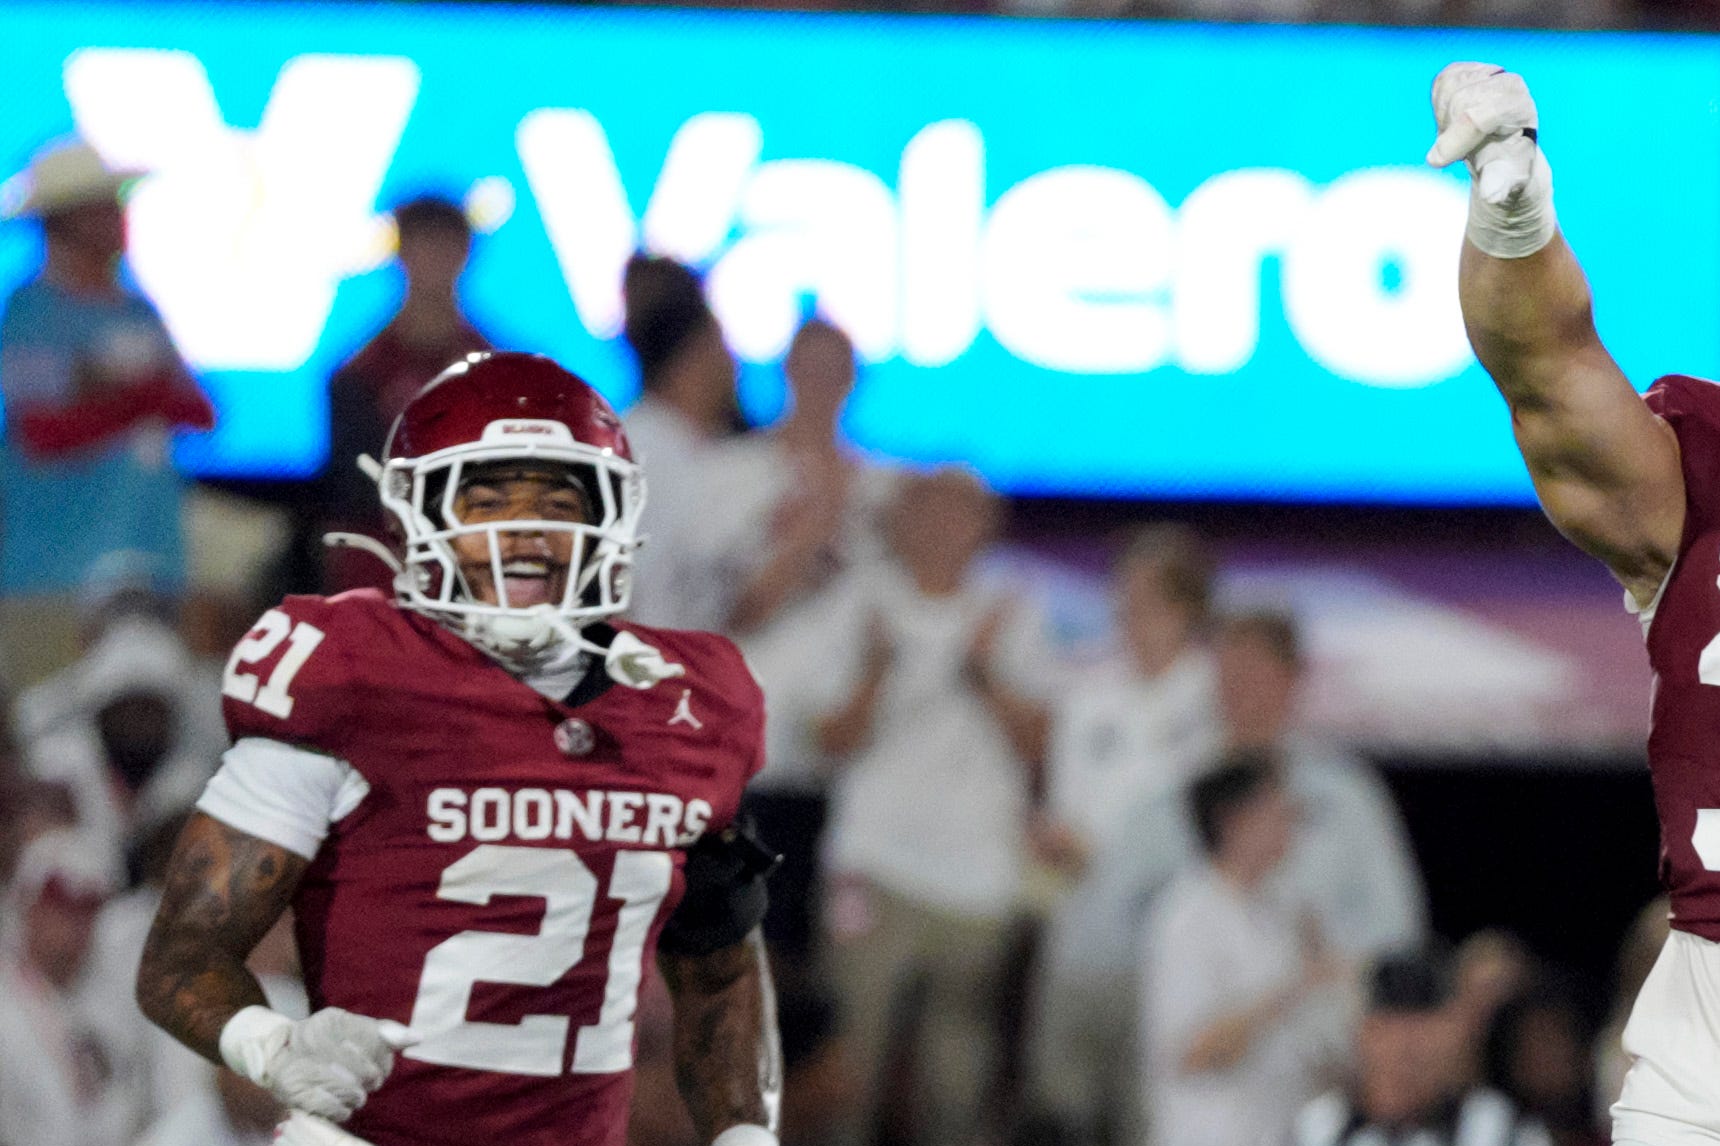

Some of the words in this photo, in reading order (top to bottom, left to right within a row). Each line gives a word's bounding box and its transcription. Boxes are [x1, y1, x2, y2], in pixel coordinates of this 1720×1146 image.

[515, 107, 1470, 387] Valero
[221, 608, 326, 720] 21
[426, 787, 713, 848] SOONERS
[403, 843, 674, 1078] 21
